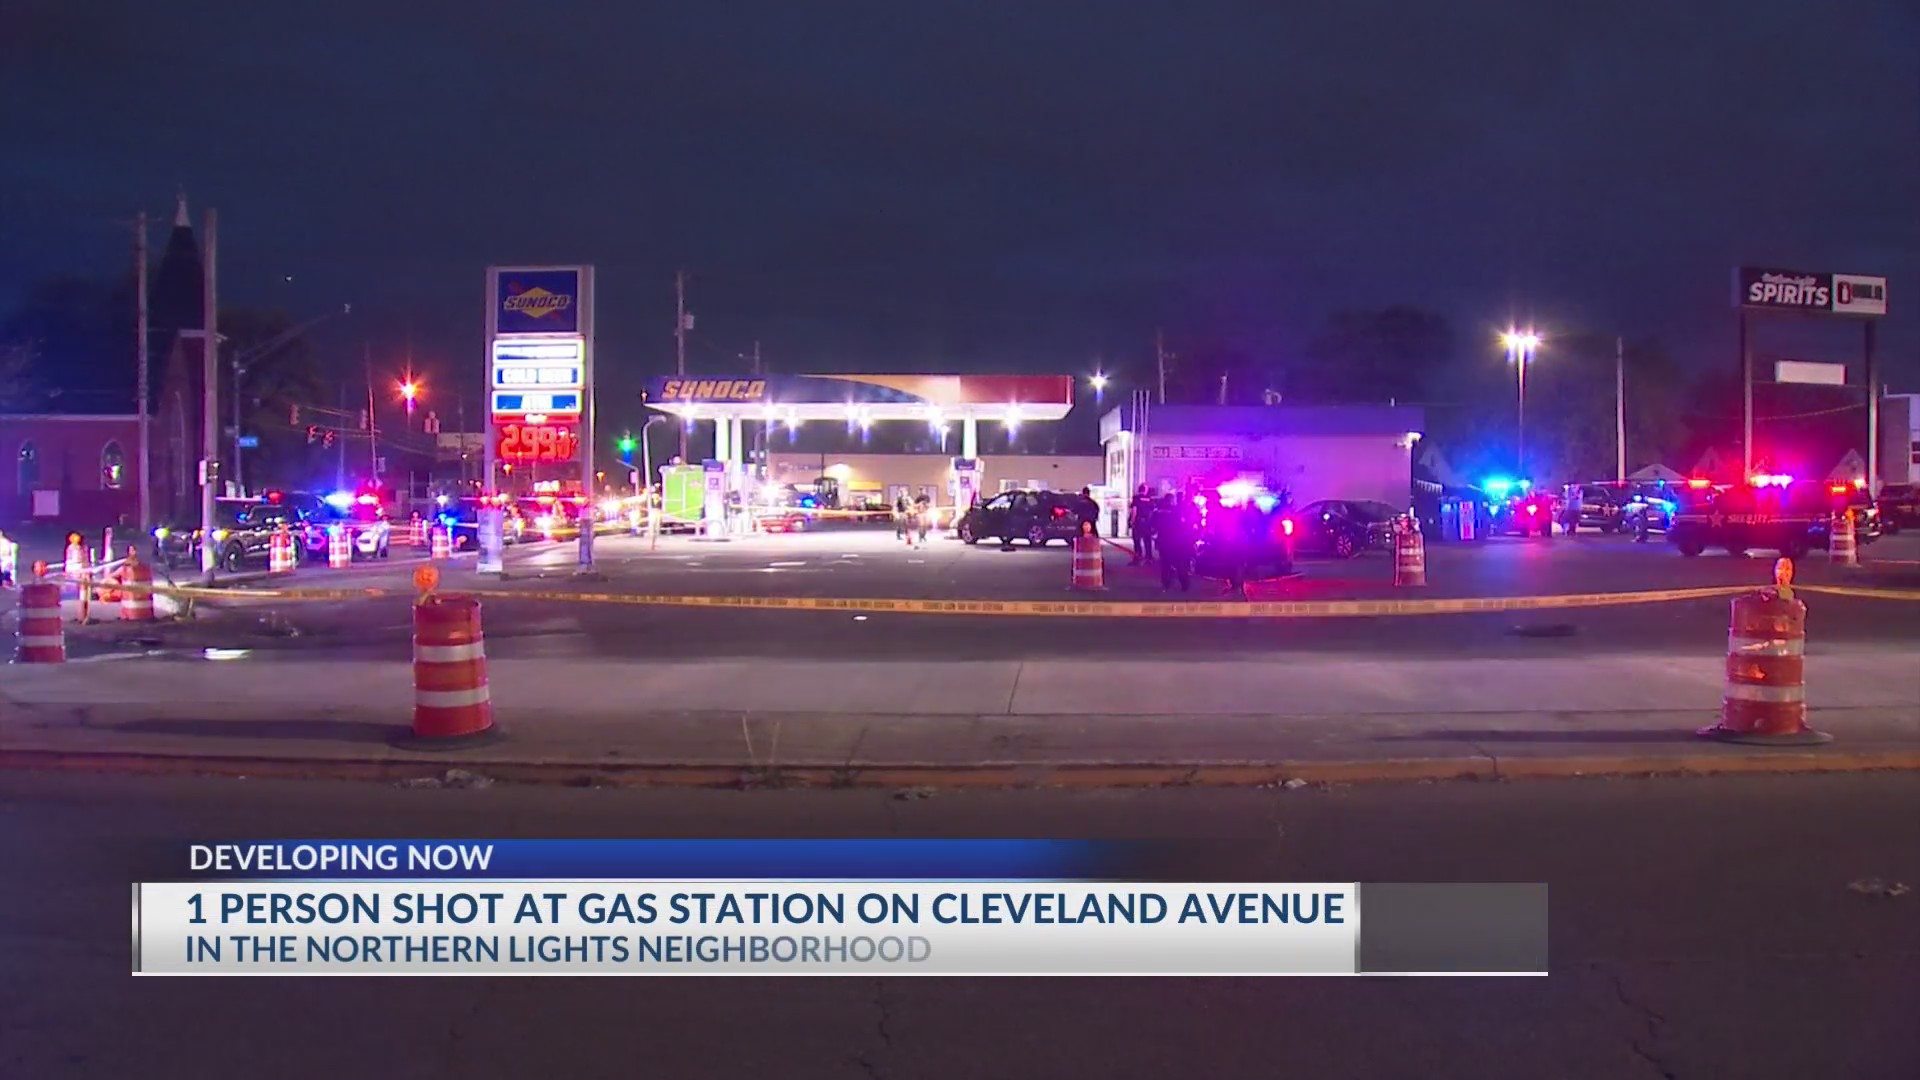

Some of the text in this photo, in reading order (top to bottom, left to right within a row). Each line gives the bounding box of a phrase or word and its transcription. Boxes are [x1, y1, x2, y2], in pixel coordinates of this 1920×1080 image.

[505, 296, 570, 309] SUNOCO
[1750, 282, 1829, 306] SPIRITS
[662, 379, 767, 400] SUNOCO
